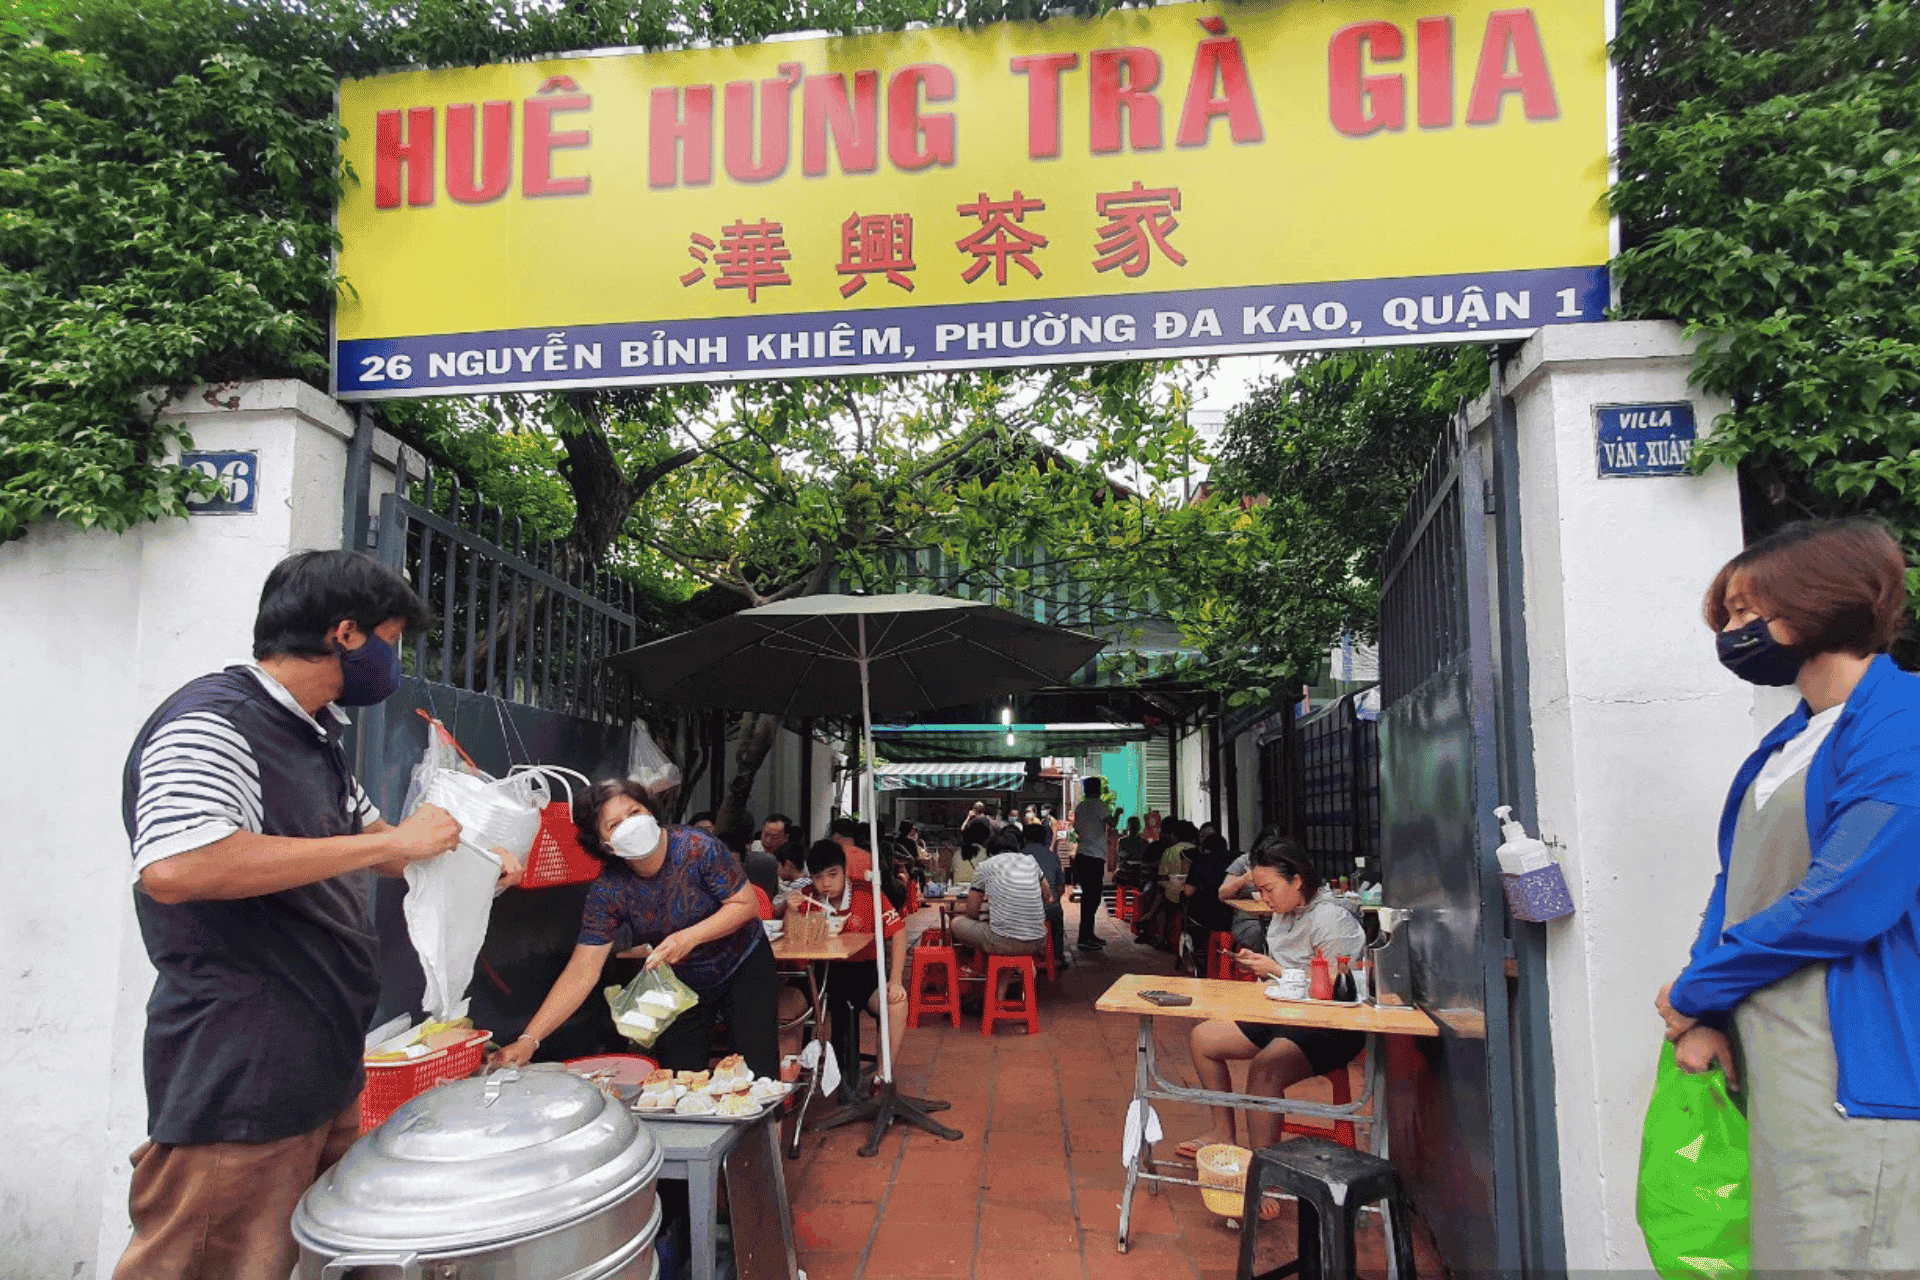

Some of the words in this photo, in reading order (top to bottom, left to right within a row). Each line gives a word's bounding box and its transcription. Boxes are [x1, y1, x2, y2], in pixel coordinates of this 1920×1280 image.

[375, 75, 592, 208] HUÊ
[648, 62, 957, 190] HƯNG
[1010, 15, 1265, 160] TRÀ
[1328, 7, 1560, 137] GIA
[358, 355, 412, 382] 26
[429, 331, 602, 379] NGUYỄN
[620, 330, 727, 368] BỈNH
[747, 322, 915, 362] KHIÊM,
[935, 311, 1136, 352] PHƯỜNG
[1152, 308, 1223, 340] ĐA
[1243, 301, 1362, 335] KAO,
[1382, 285, 1530, 331] QUẬN
[1555, 288, 1583, 317] 1
[1619, 410, 1672, 429] VILLA
